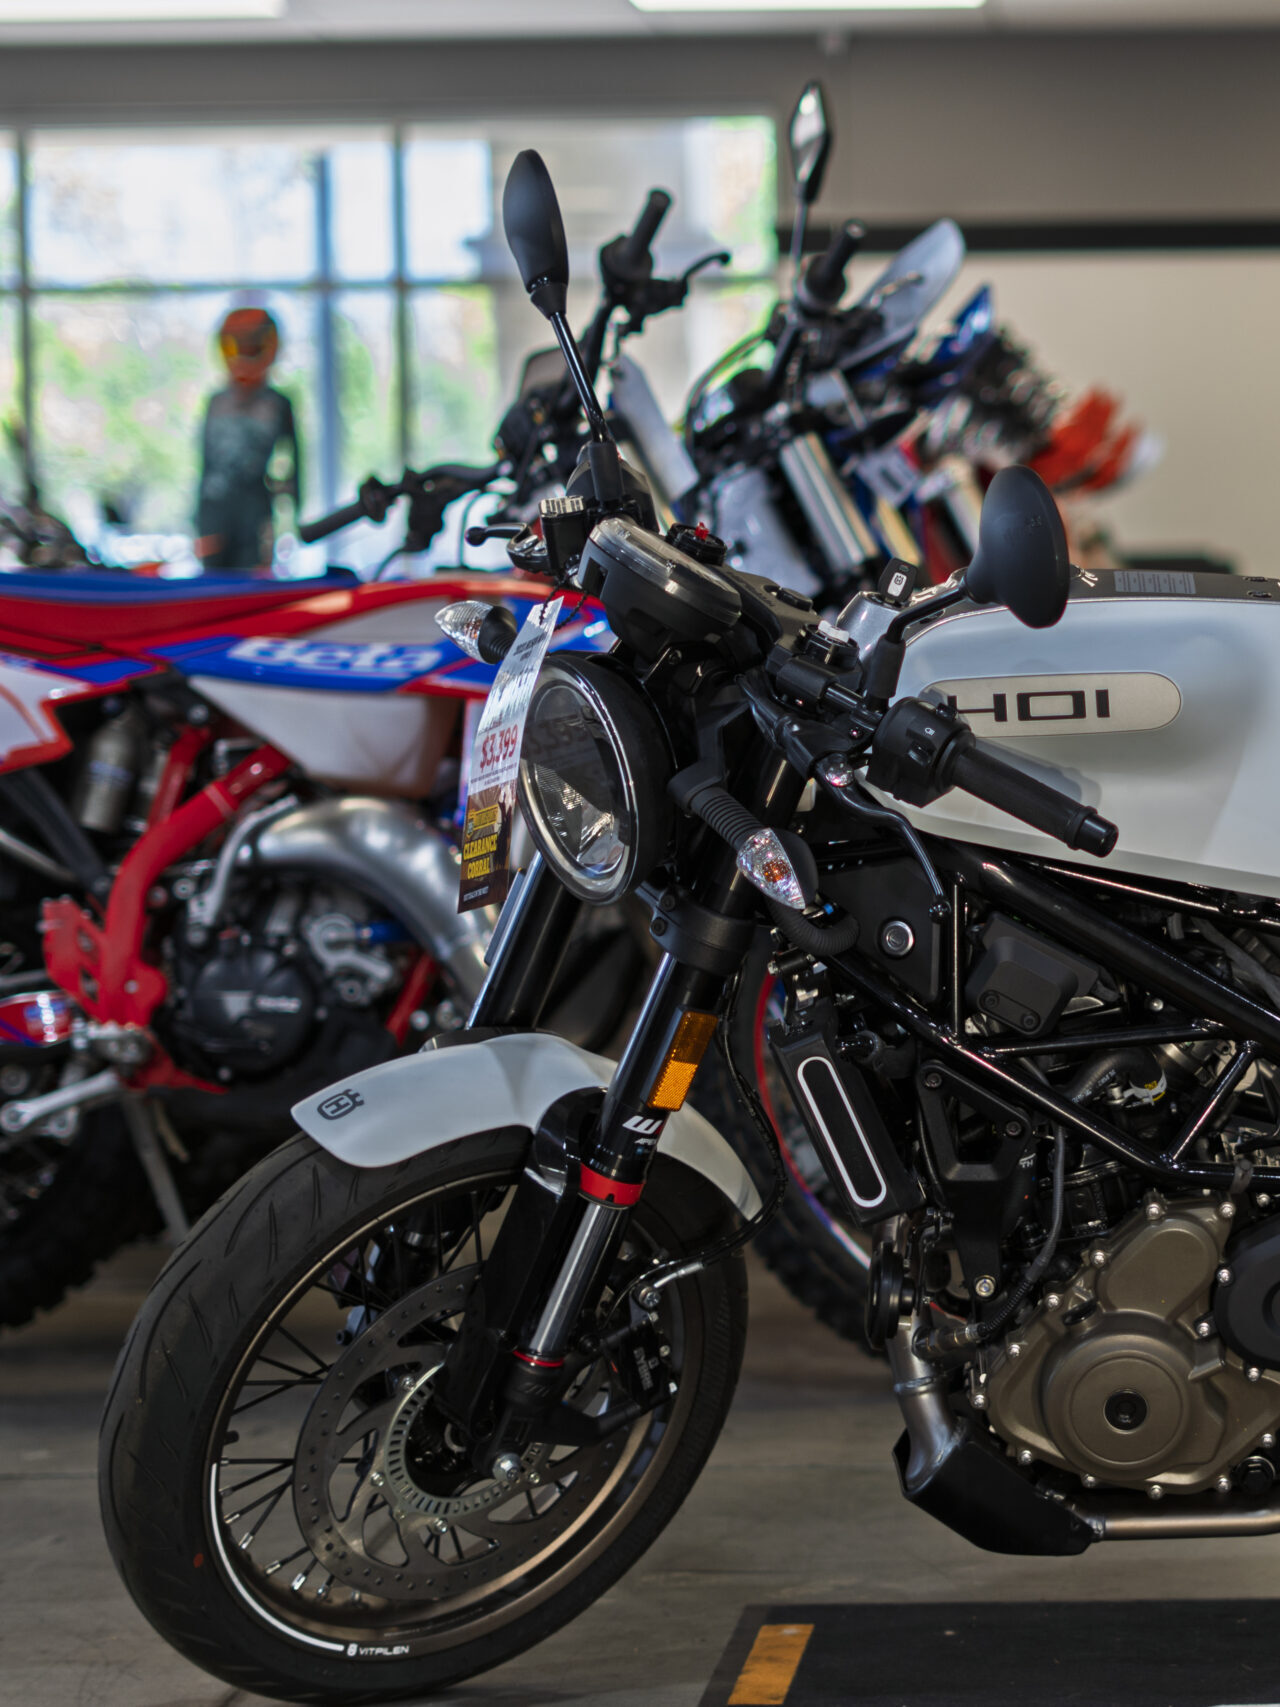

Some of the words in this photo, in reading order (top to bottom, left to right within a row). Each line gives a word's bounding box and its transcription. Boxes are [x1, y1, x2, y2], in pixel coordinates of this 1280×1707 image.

[480, 724, 518, 773] $3,399
[463, 834, 498, 860] CLEARANCE
[467, 857, 491, 880] CORRAL
[359, 1645, 410, 1656] VITPILEN
